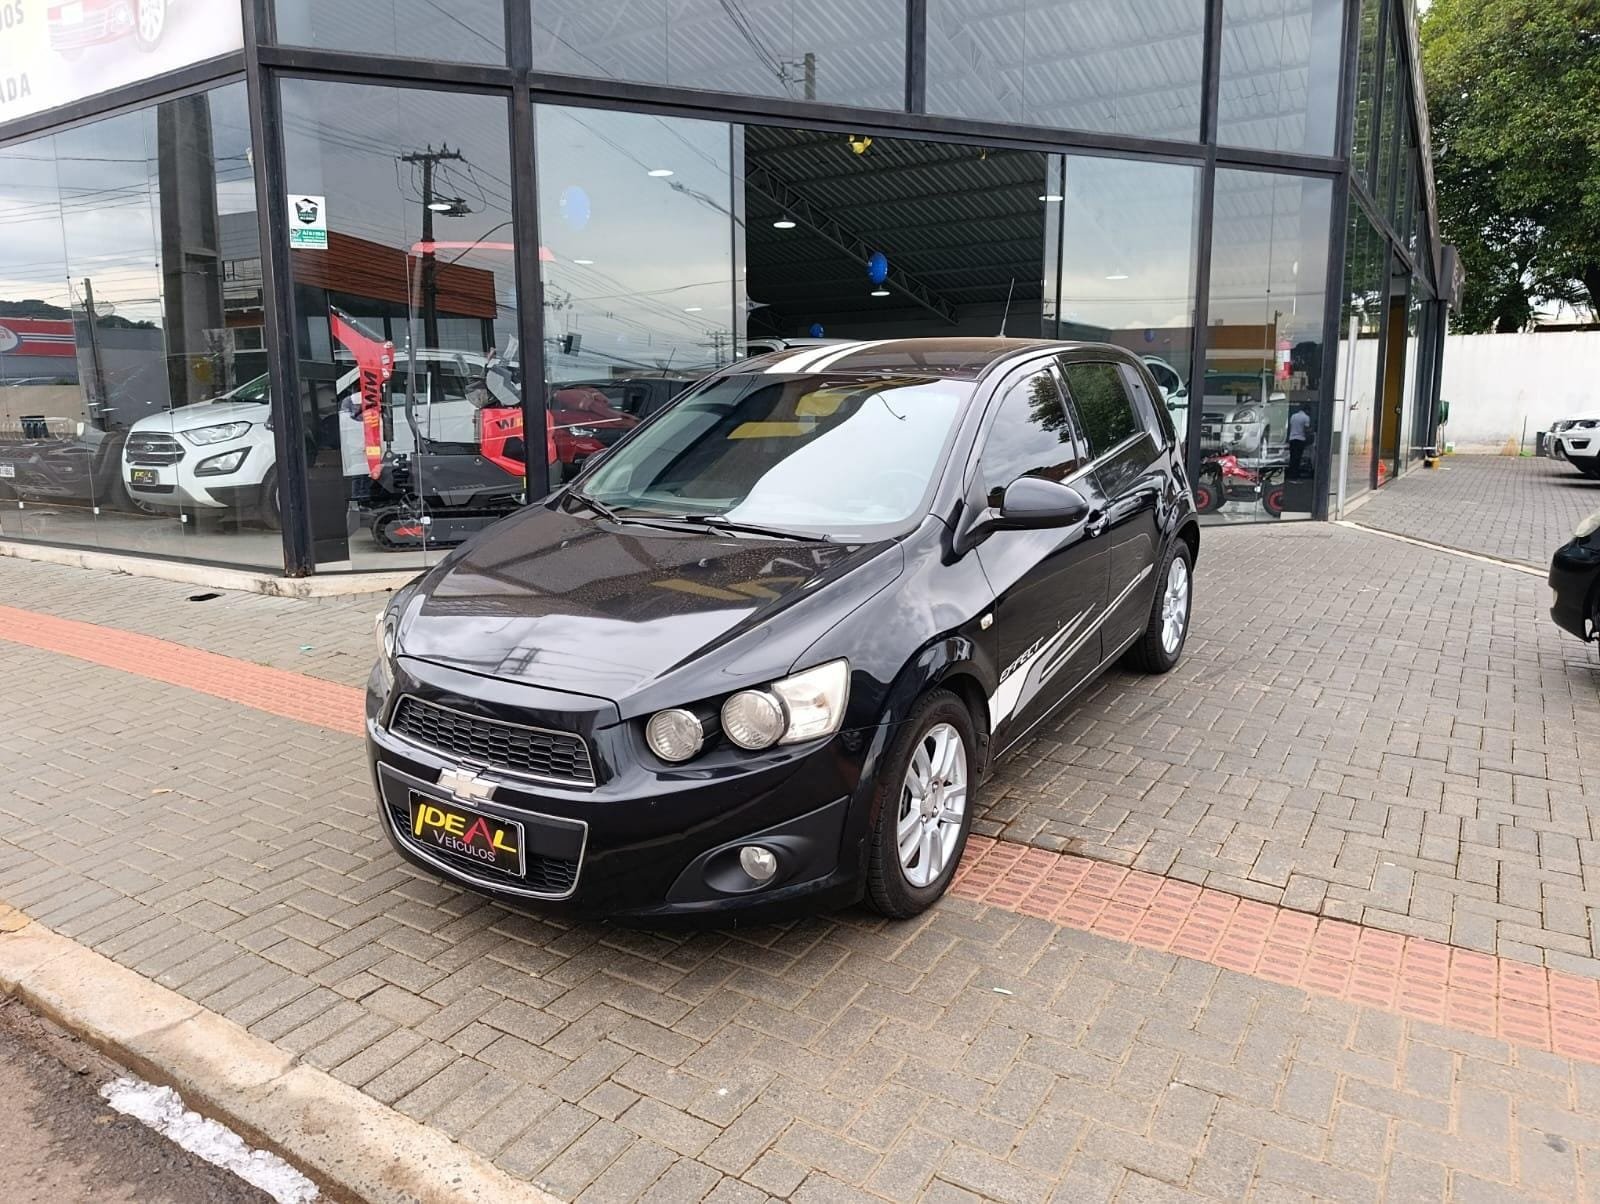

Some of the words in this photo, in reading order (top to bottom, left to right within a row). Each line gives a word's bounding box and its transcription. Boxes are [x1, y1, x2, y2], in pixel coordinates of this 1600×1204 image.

[0, 0, 24, 32] OS
[999, 636, 1045, 683] EFFECT
[414, 803, 517, 855] IDEAL
